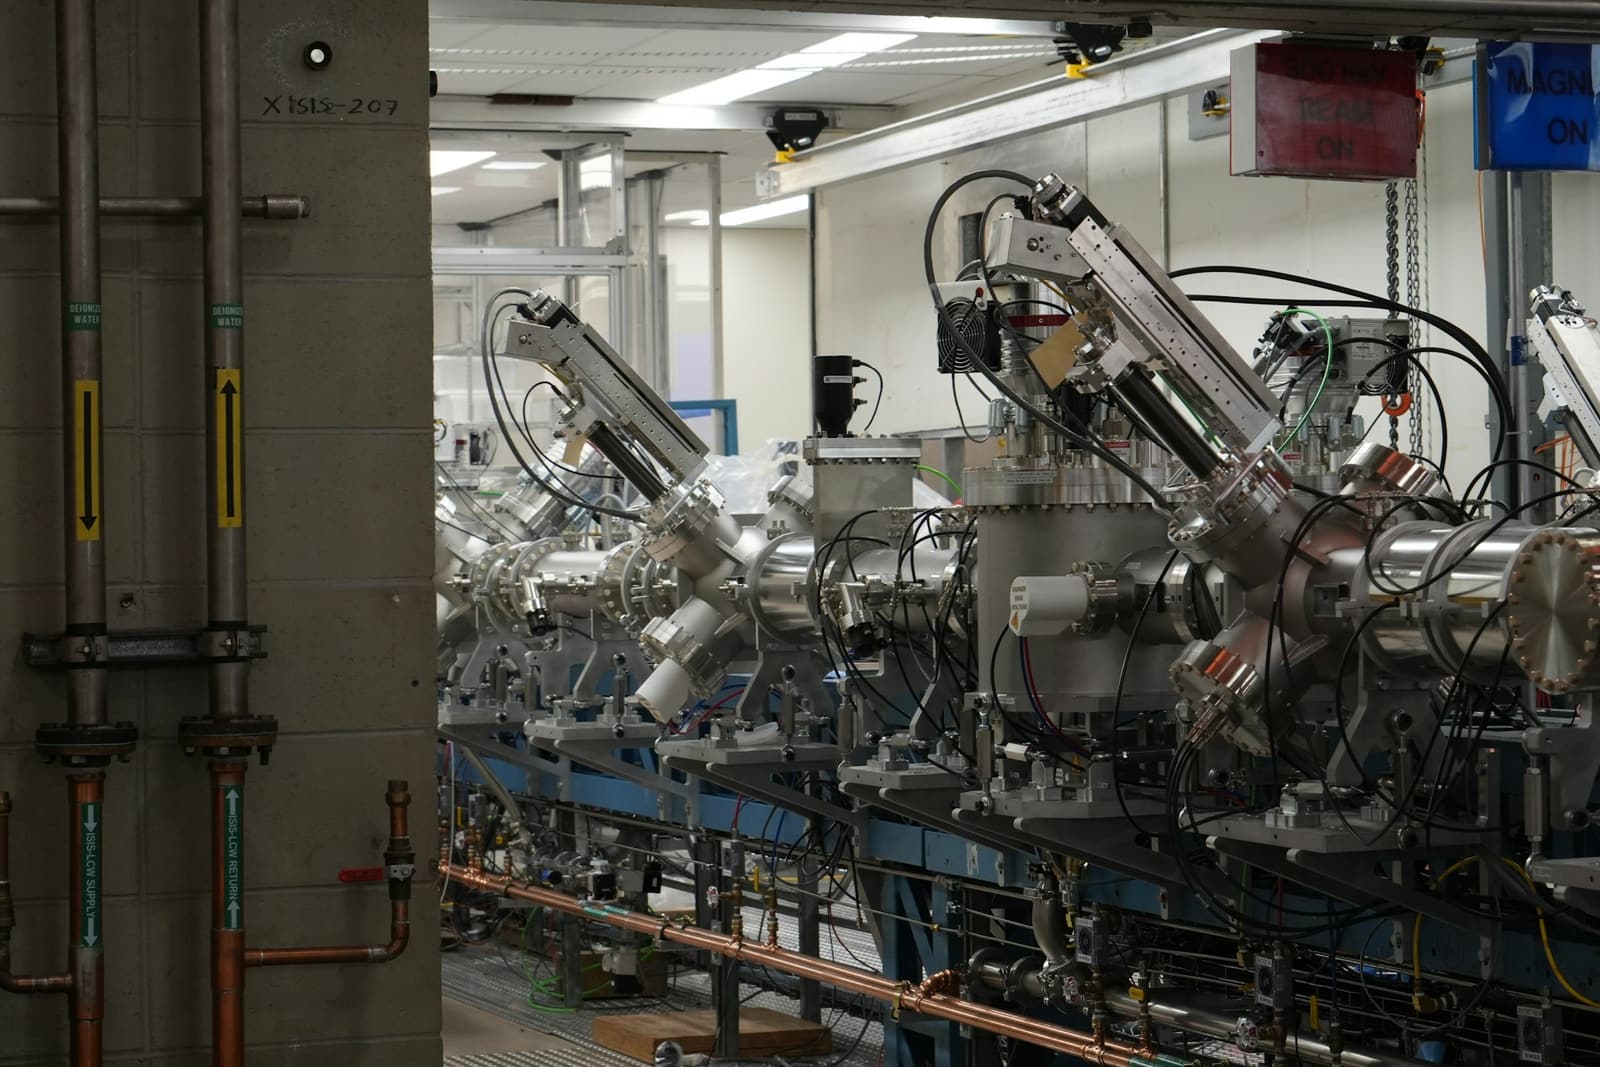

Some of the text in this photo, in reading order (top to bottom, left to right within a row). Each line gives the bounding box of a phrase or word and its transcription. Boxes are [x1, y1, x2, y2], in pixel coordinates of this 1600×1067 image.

[1316, 135, 1355, 160] ON
[1547, 116, 1589, 145] ON
[85, 832, 97, 918] ISIS-LCW SUPPLY
[228, 815, 239, 900] ISIS-LCW RETURN
